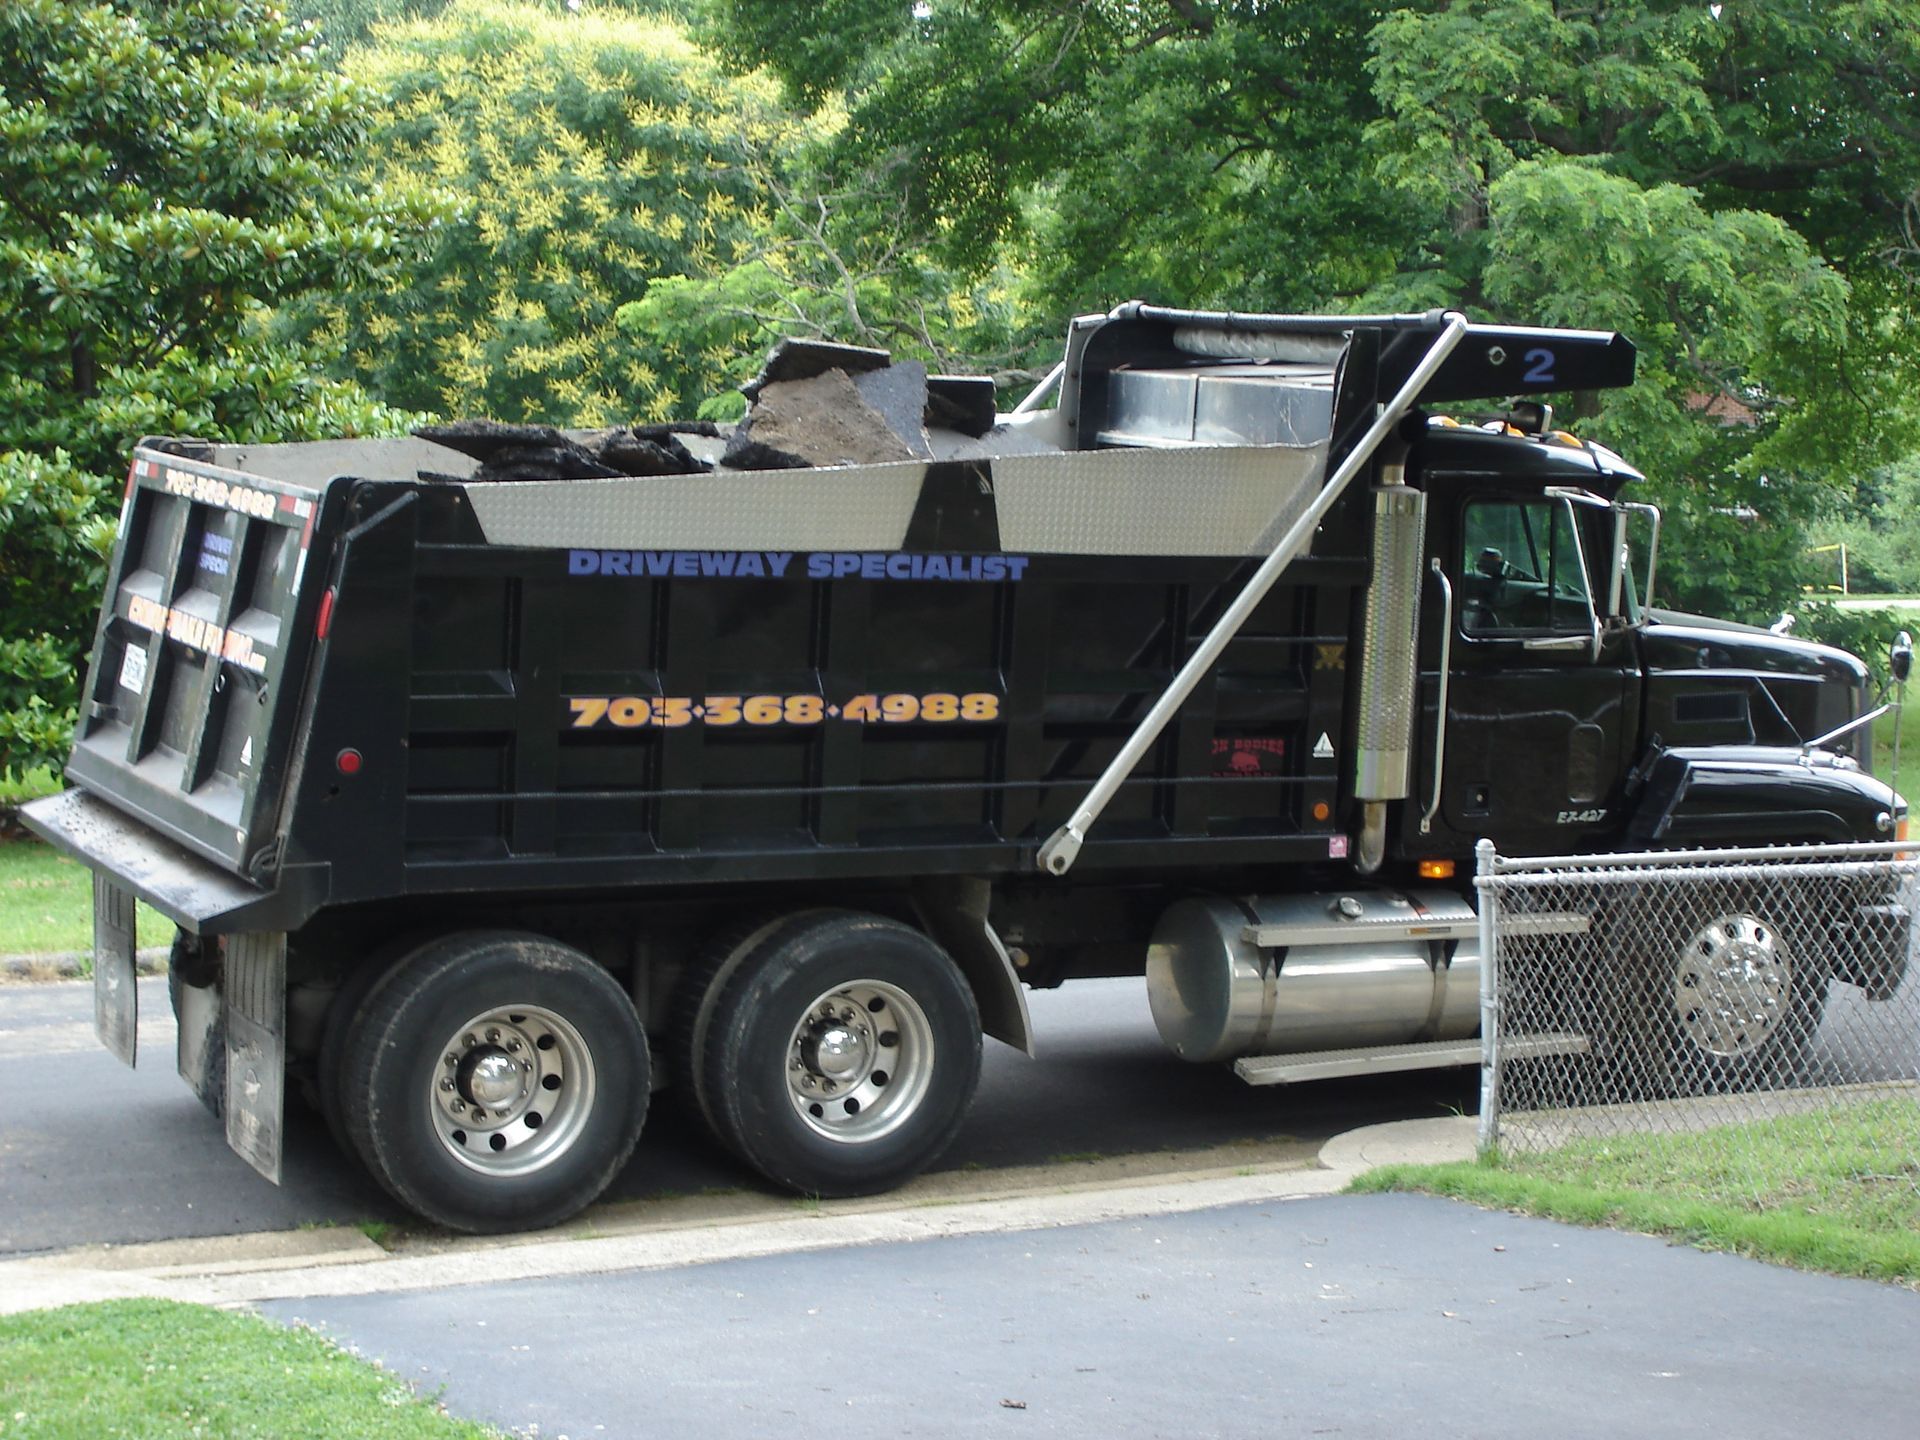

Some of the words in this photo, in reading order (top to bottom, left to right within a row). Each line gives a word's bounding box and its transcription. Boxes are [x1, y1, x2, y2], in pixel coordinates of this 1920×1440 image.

[1523, 348, 1556, 382] 2
[568, 549, 793, 576] DRIVEWAY
[807, 553, 1029, 581] SPECIALIST
